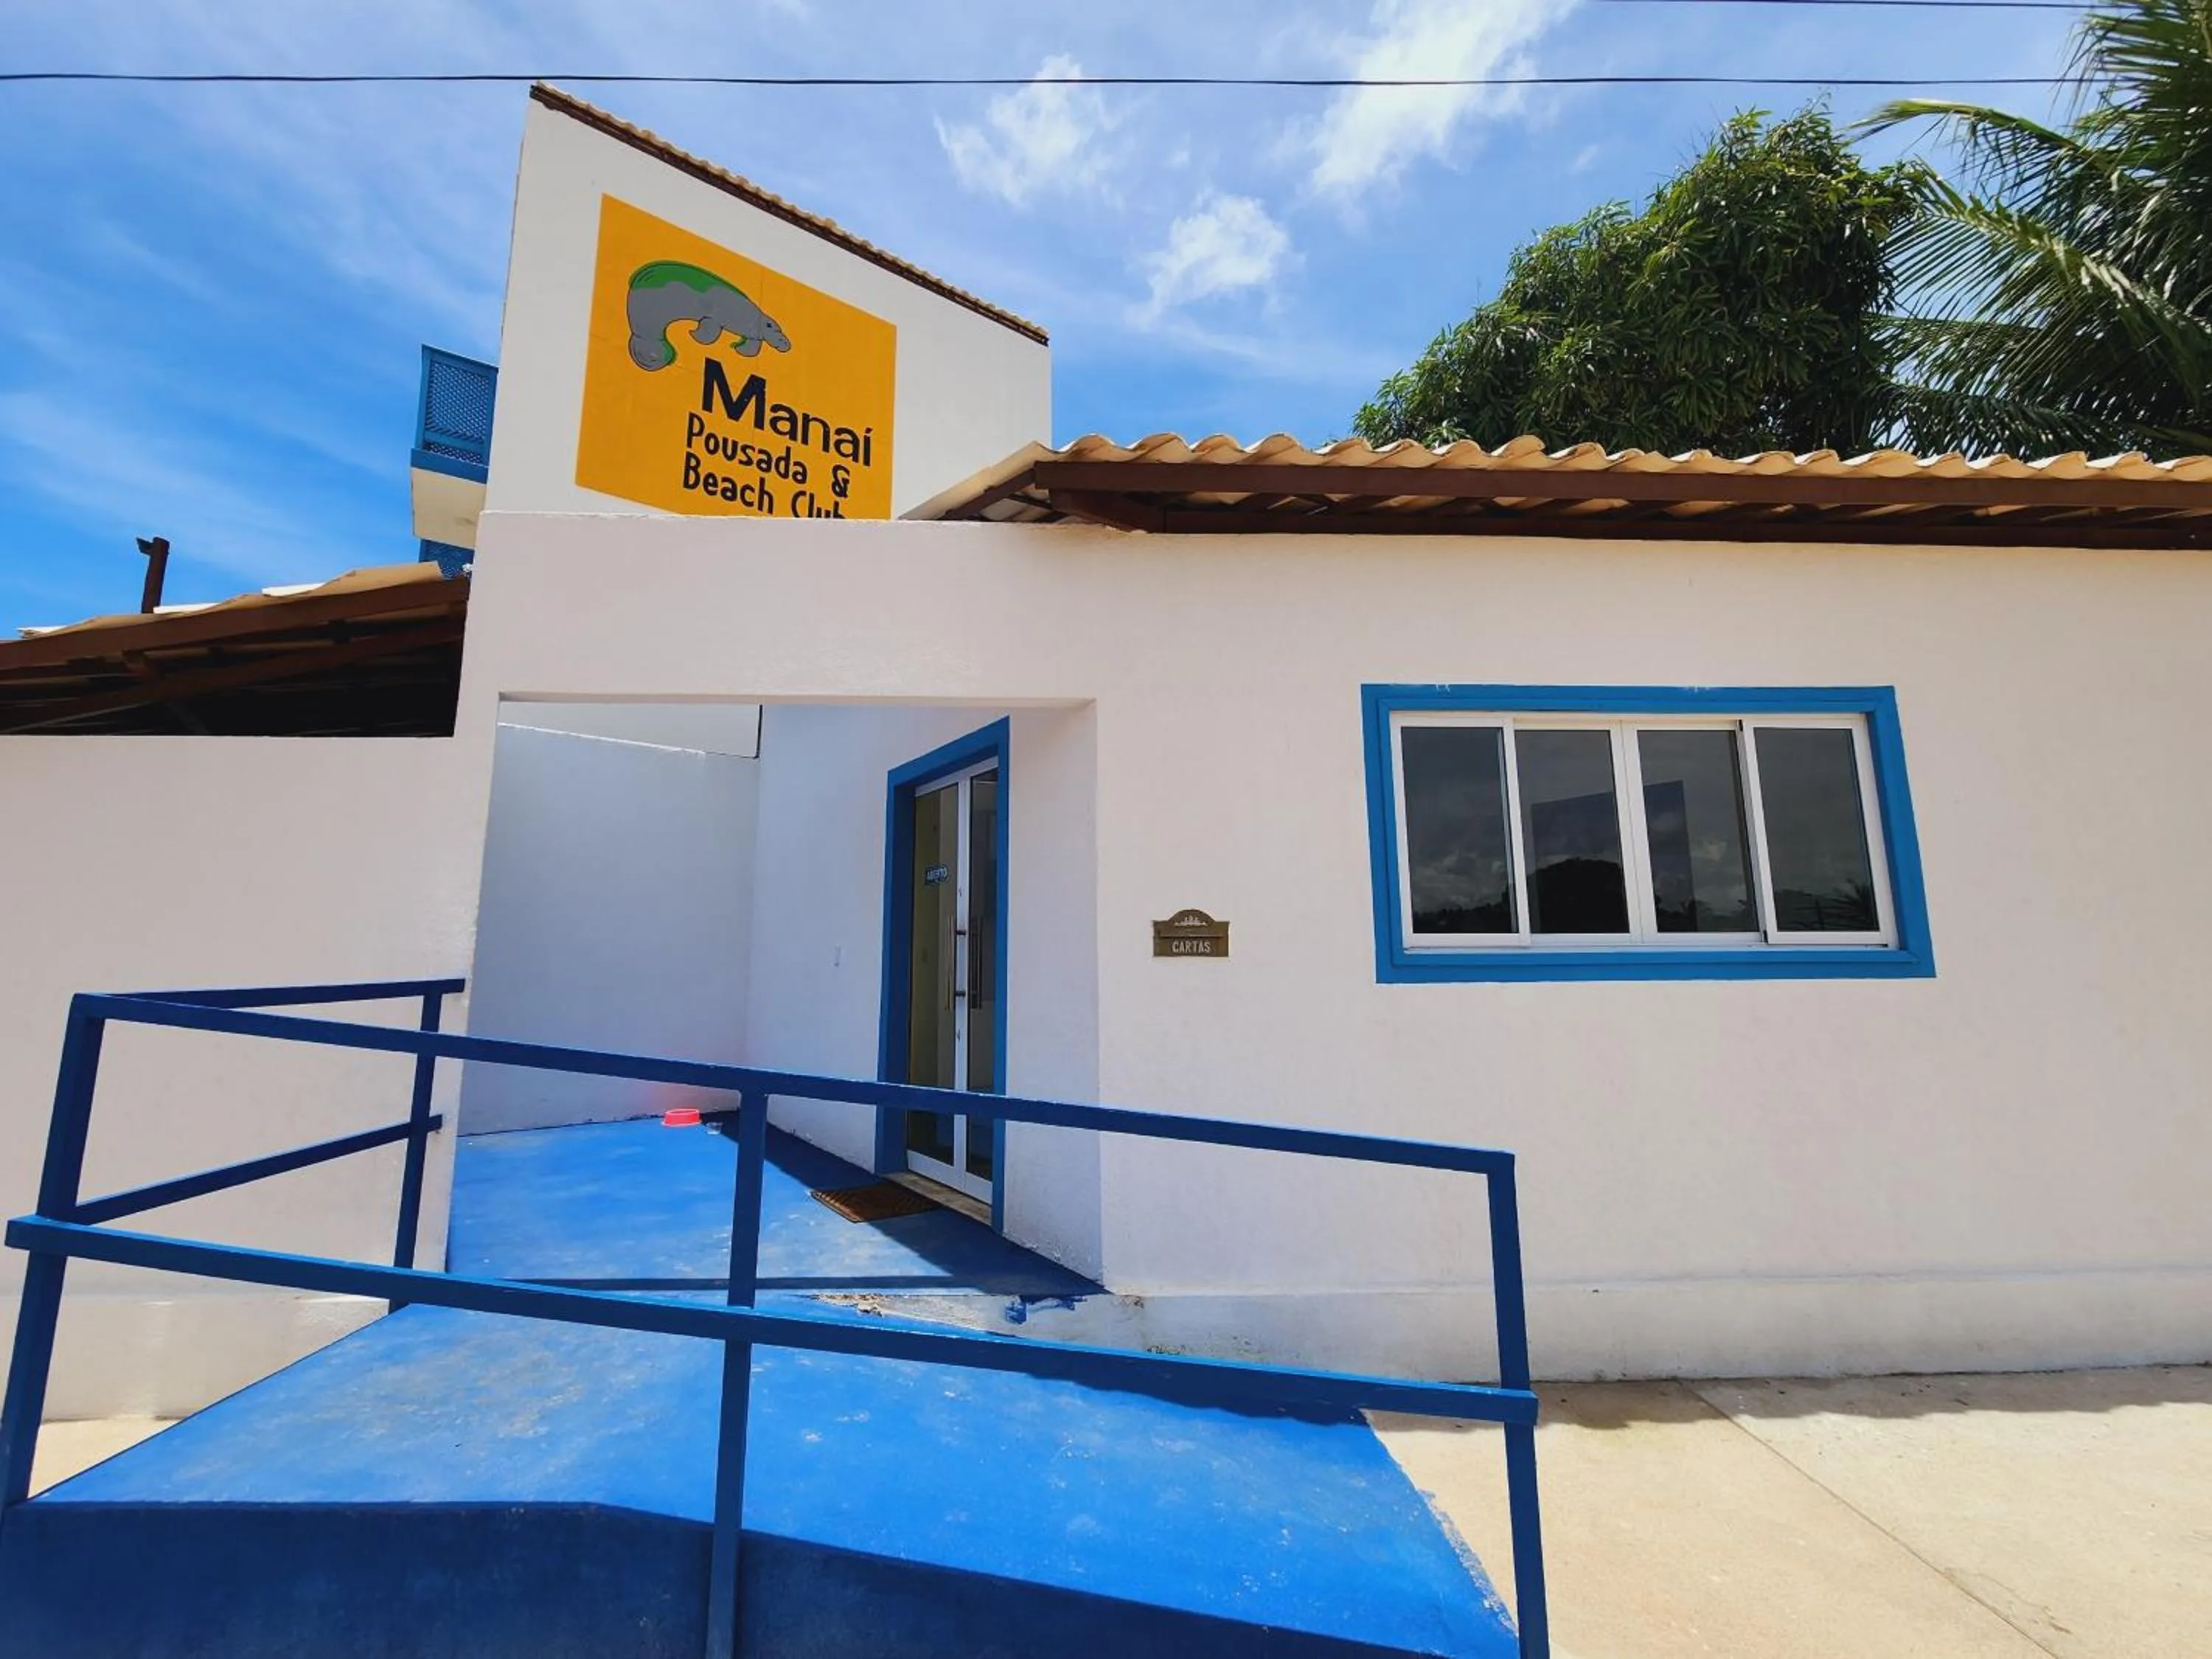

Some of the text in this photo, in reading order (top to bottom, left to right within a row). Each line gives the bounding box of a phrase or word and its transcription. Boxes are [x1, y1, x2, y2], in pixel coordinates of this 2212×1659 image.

[701, 357, 873, 467] Manaí
[683, 451, 774, 515] Beach
[686, 411, 849, 498] Pousada &
[1172, 940, 1211, 953] CARTAS
